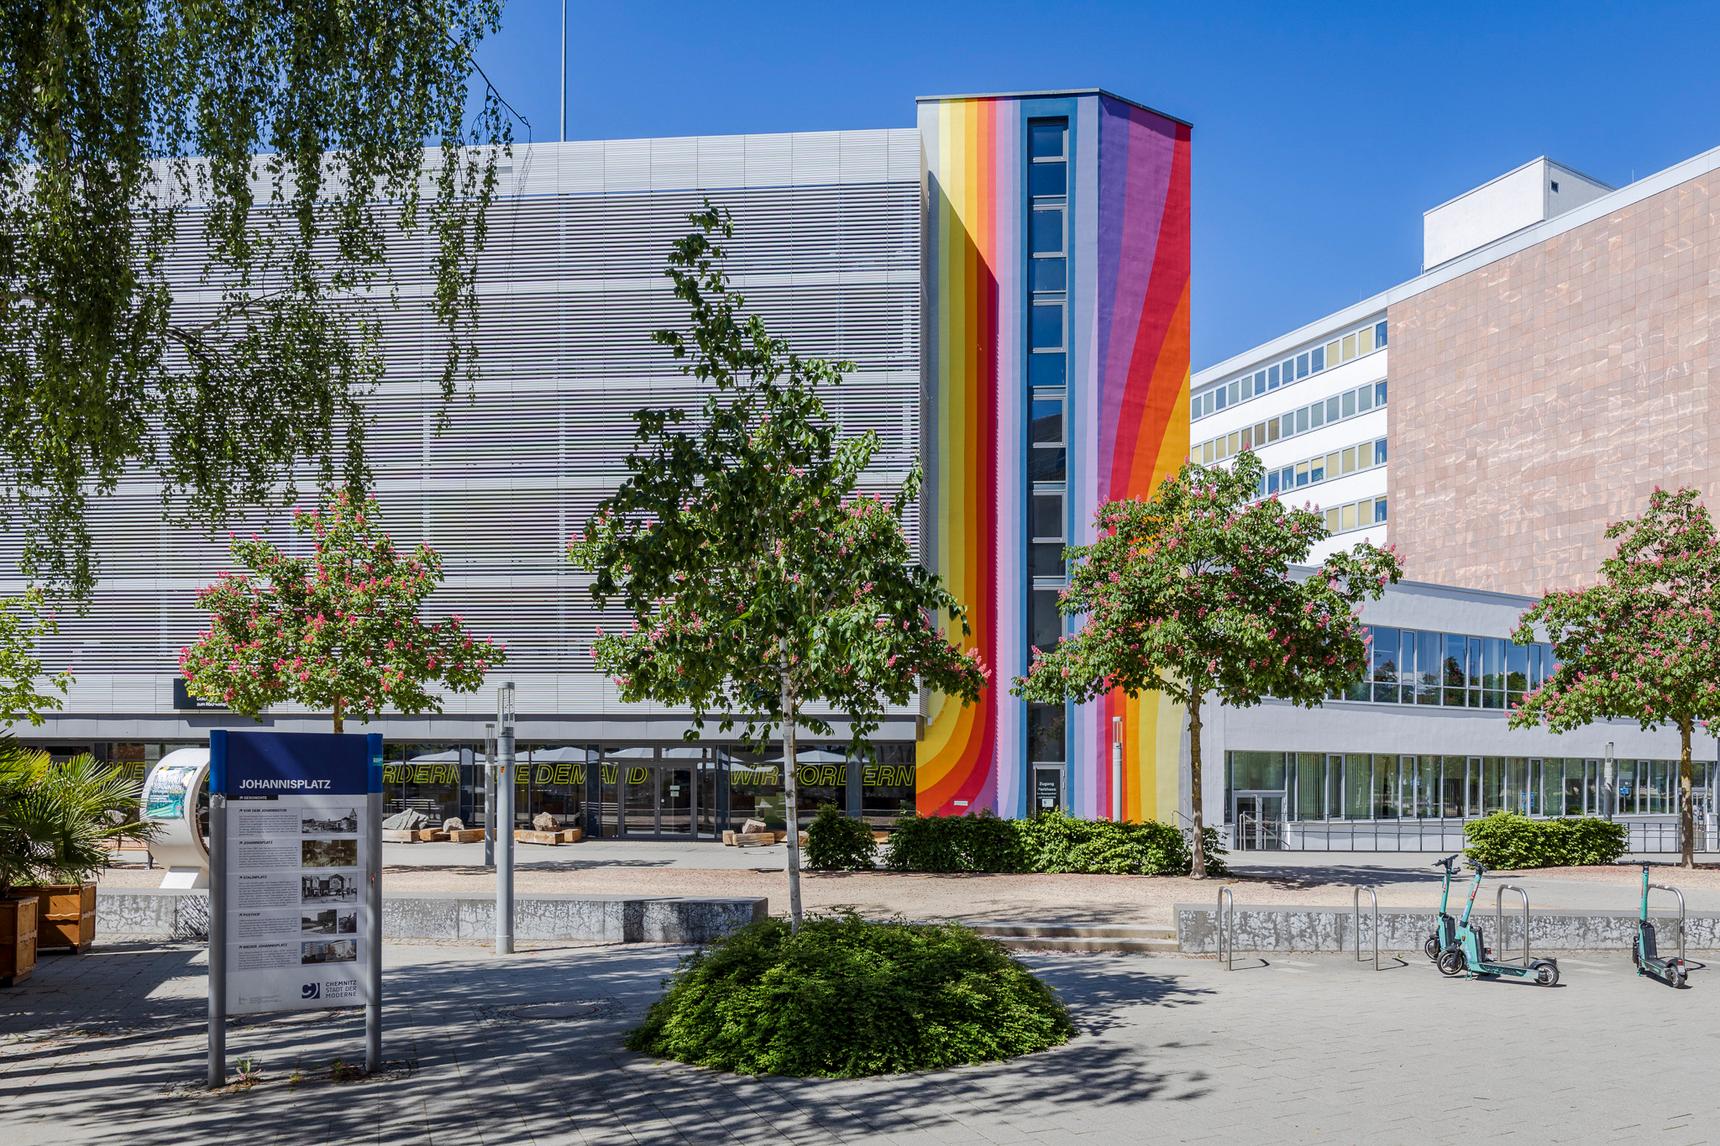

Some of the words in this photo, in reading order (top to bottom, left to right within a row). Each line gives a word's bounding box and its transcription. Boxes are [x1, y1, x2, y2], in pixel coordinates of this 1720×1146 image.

[382, 763, 461, 784] RDERN
[730, 764, 780, 785] WIR
[795, 764, 915, 787] ORERN
[239, 779, 331, 789] JOHANNISPLATZ
